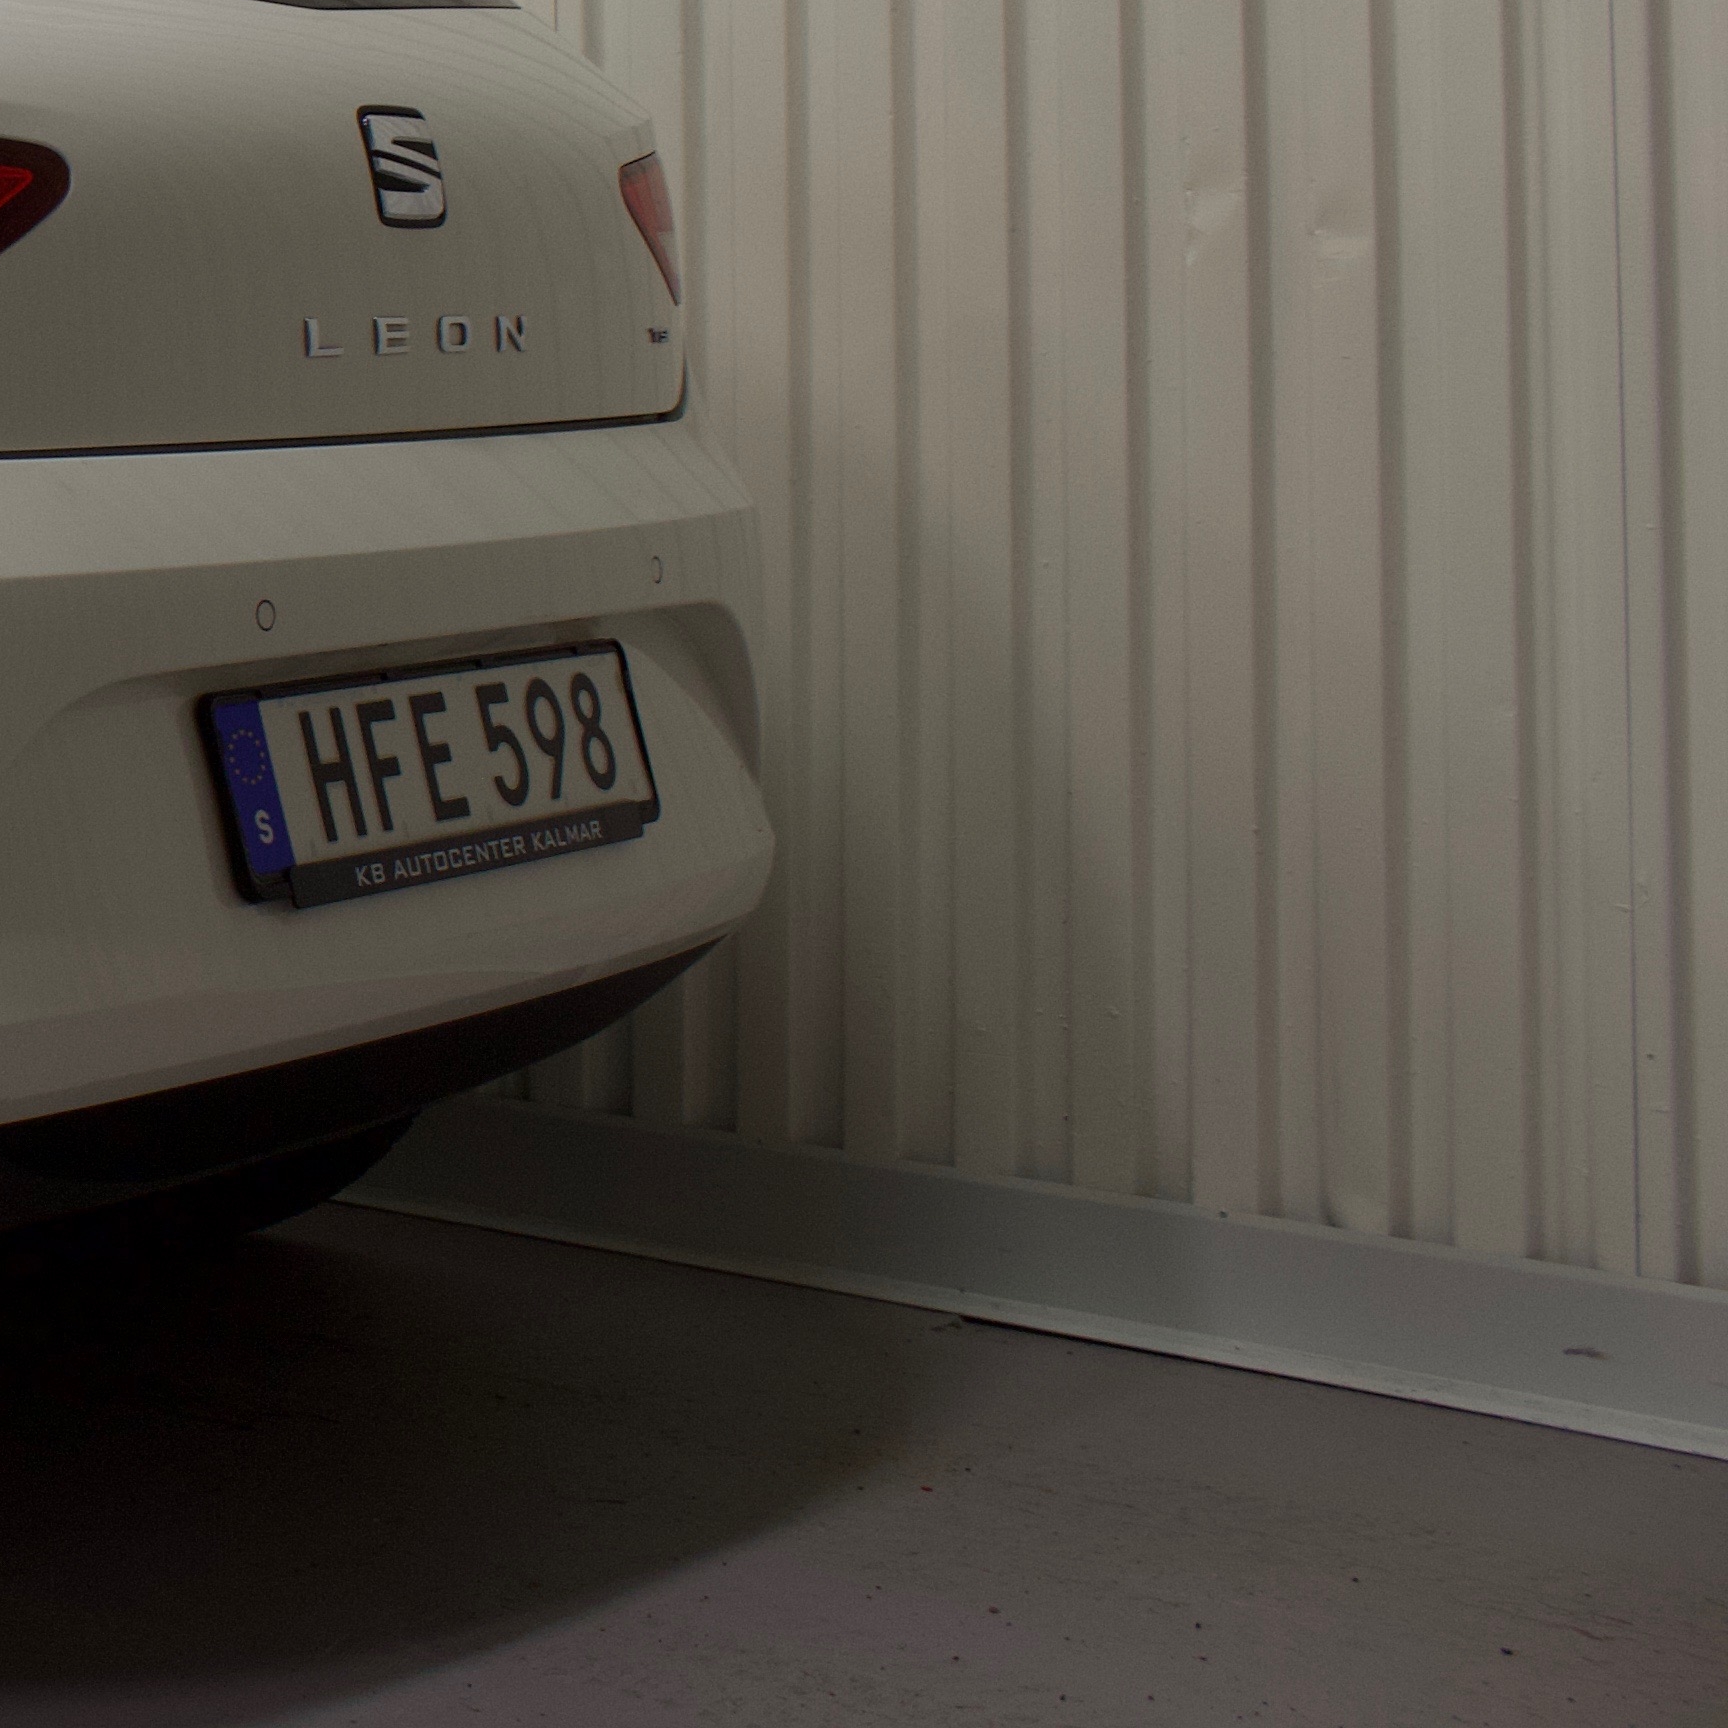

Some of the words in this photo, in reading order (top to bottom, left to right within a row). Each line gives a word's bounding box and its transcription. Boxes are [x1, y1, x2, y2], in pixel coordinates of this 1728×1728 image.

[304, 315, 527, 357] LEON
[298, 691, 470, 843] HFE
[475, 672, 617, 807] 598
[254, 808, 274, 844] S
[355, 862, 386, 888] KB
[394, 836, 527, 881] AUTOCENTER
[531, 819, 603, 853] KALMAR
